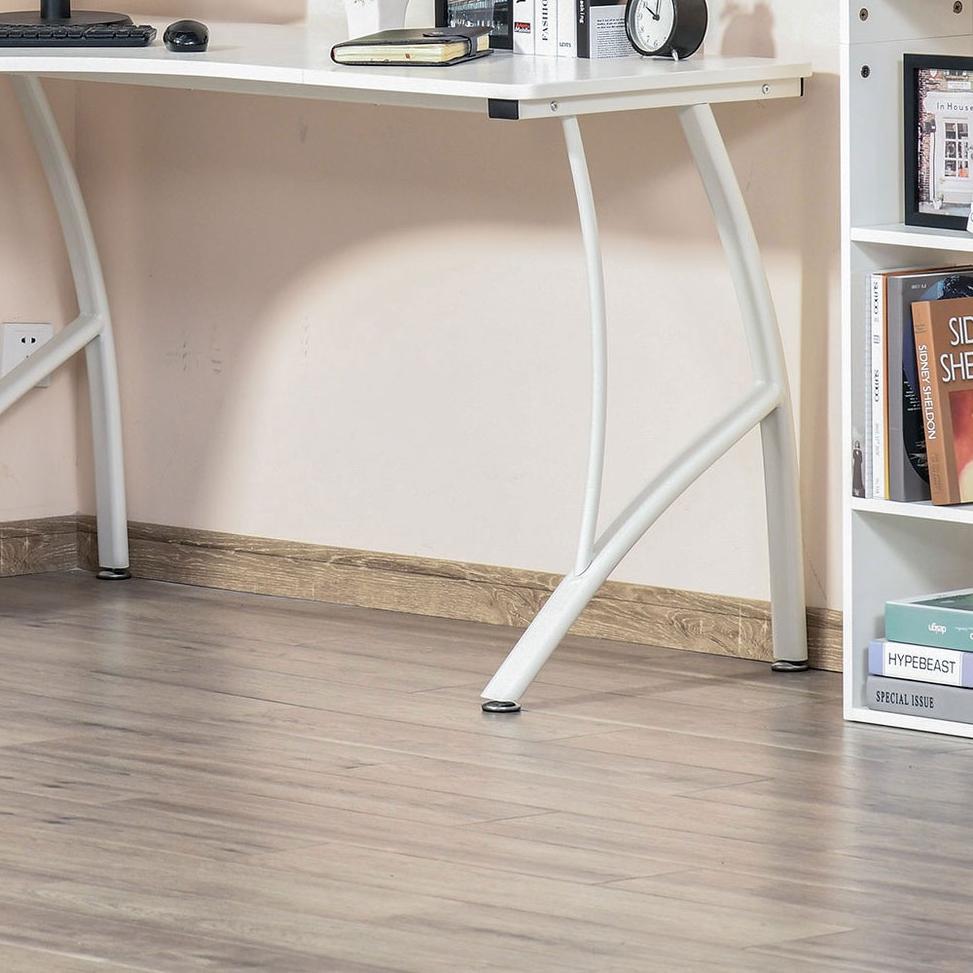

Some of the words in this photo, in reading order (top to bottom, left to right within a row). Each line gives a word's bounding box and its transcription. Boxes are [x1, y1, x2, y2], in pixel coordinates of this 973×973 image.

[919, 344, 930, 383] SIDNEY
[940, 351, 973, 382] SHE
[922, 386, 936, 440] SHELDON
[888, 652, 956, 674] HYPEBEAST
[876, 690, 909, 706] SPECIAL
[911, 694, 934, 709] ISSUE
